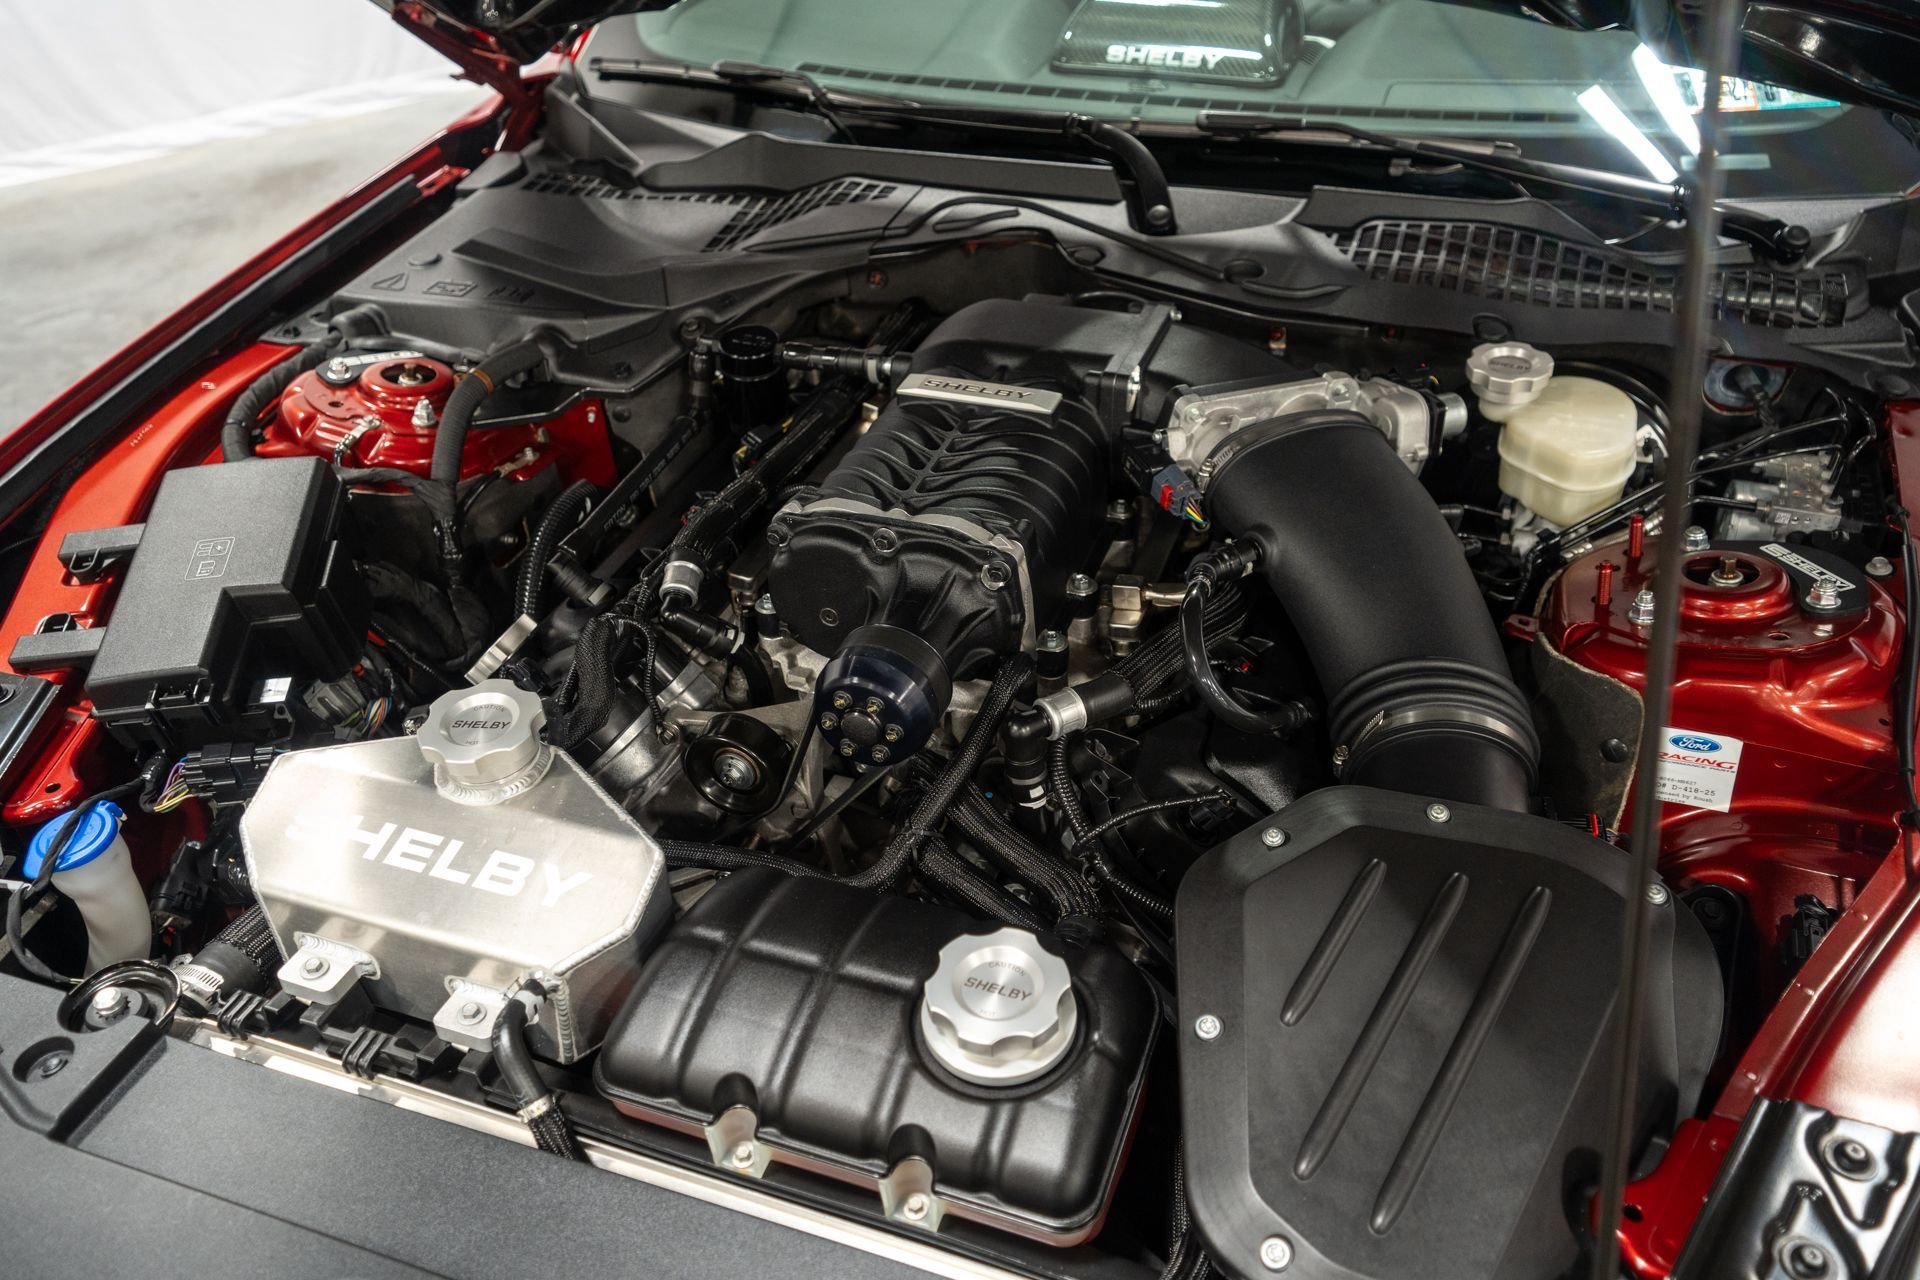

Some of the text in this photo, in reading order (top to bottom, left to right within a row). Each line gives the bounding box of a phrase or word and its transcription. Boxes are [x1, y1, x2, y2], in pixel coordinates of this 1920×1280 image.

[1105, 44, 1226, 70] SHELBY
[924, 379, 1033, 399] SHELBY
[473, 704, 505, 712] CAUTION
[452, 720, 511, 729] SHELBY
[1678, 736, 1712, 751] Ford
[1671, 784, 1716, 796] D-418-25
[988, 961, 1026, 976] CAUTION
[963, 977, 1032, 1001] SHELBY
